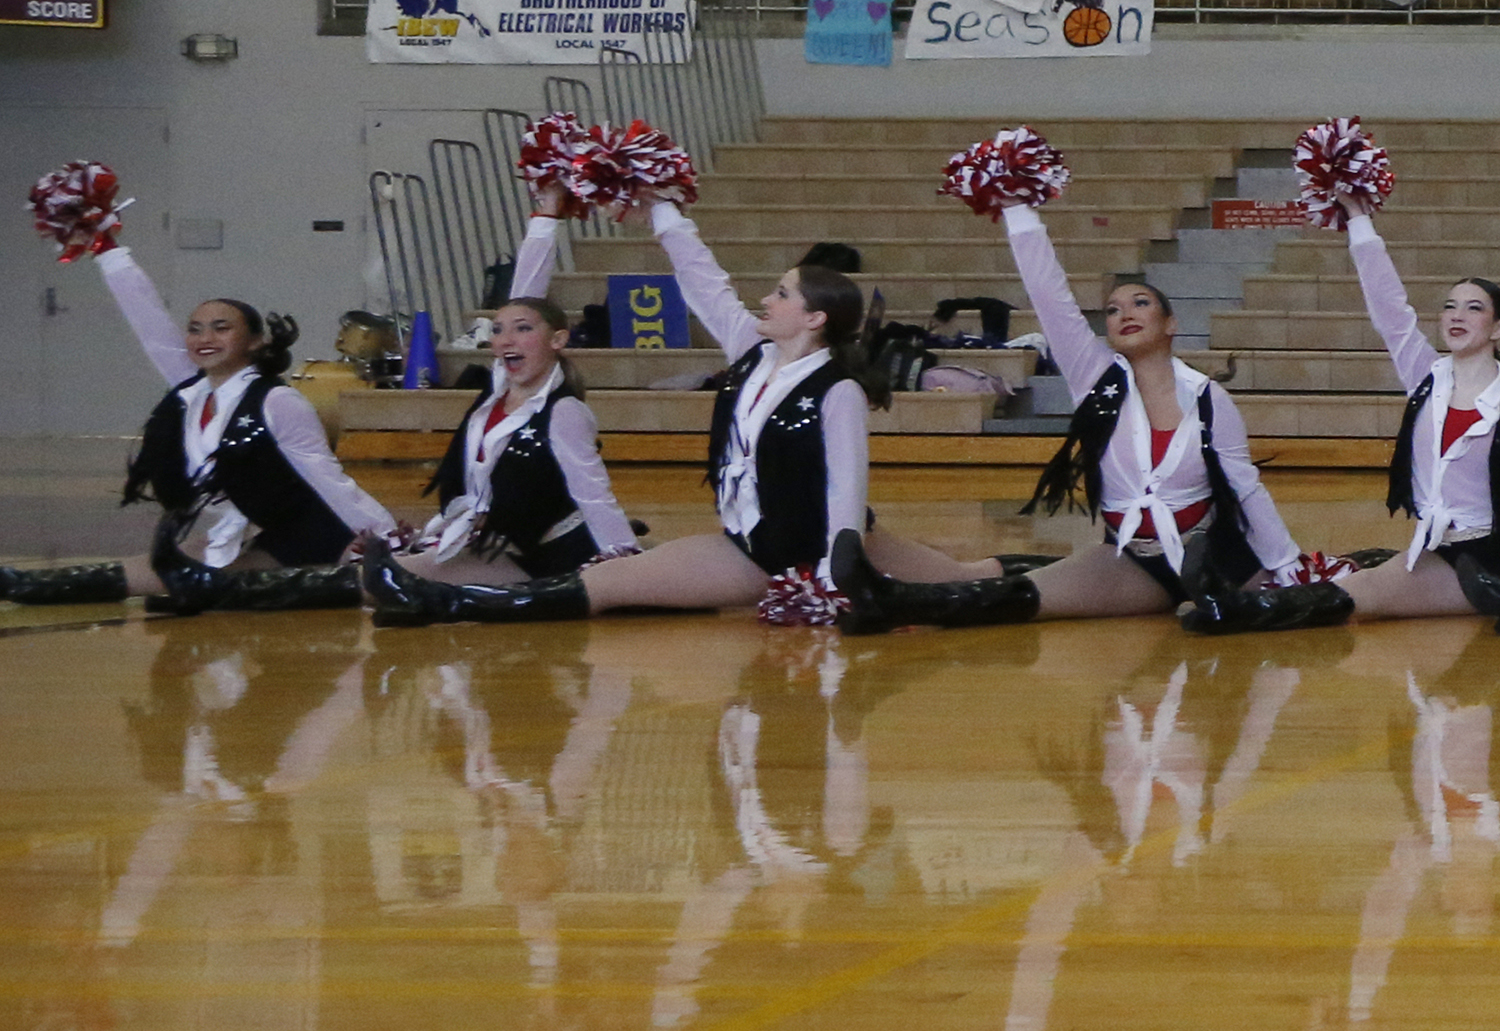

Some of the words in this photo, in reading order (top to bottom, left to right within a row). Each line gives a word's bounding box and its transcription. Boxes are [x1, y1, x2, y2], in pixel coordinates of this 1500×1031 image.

[28, 0, 92, 19] SCORE
[498, 12, 594, 33] ELECTRICAL
[603, 12, 686, 34] WORKERS
[556, 39, 594, 49] LOCAL
[600, 39, 626, 49] 1547
